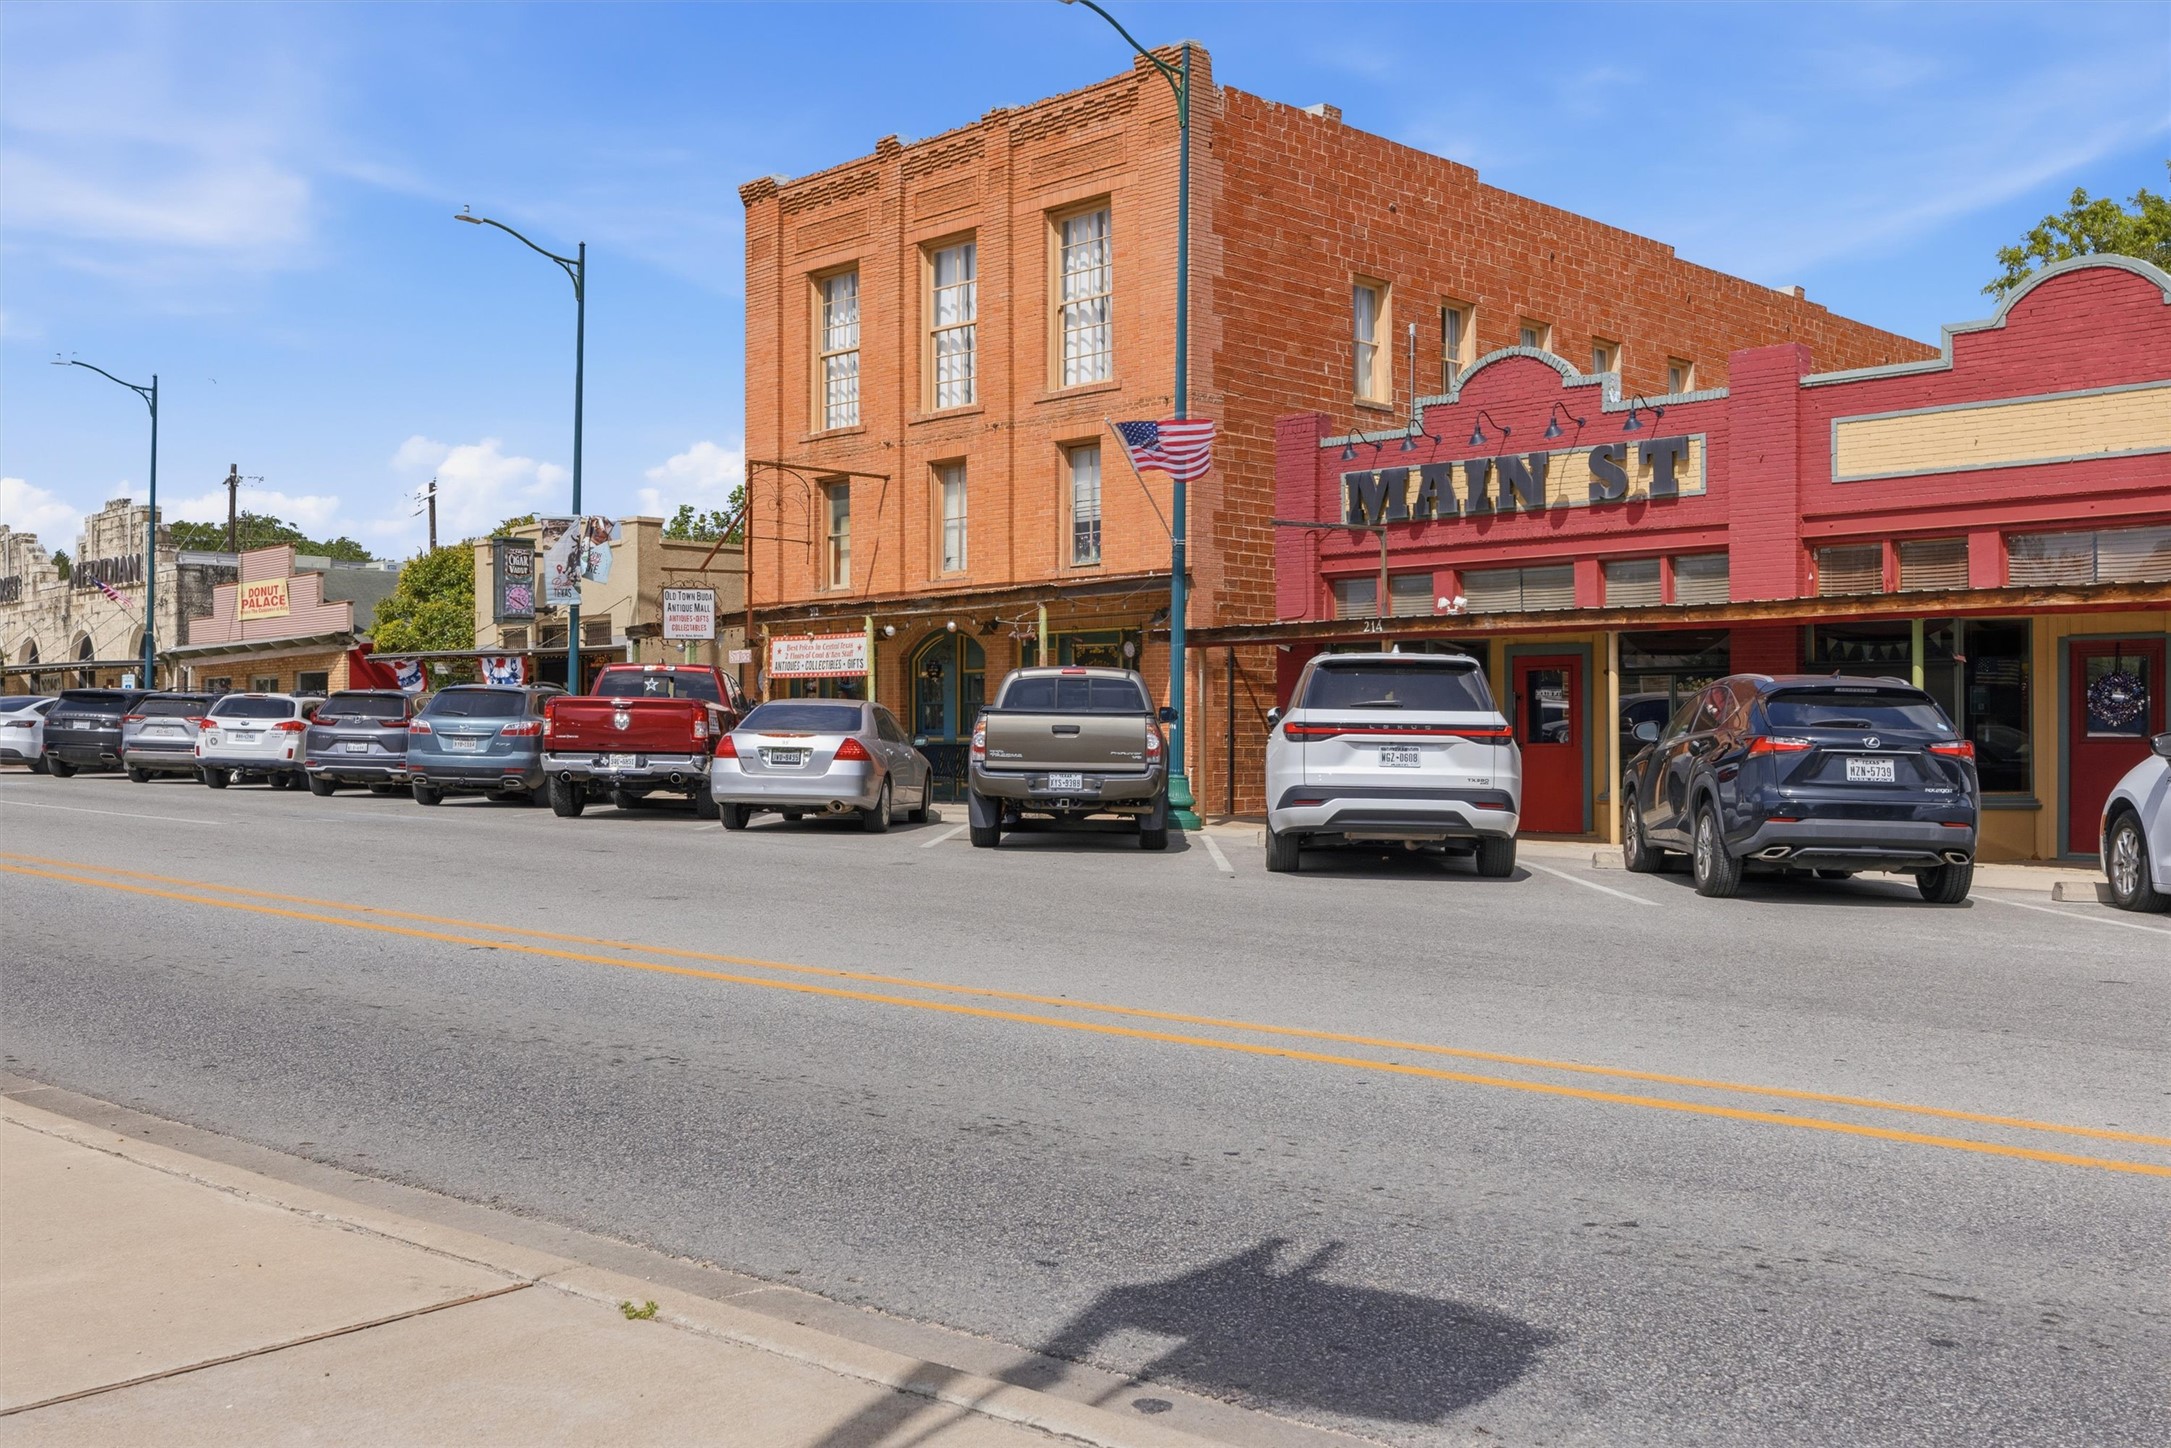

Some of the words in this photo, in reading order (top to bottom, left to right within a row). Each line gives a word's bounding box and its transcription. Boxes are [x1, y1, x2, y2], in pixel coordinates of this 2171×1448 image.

[1346, 451, 1548, 524] MAIN
[1588, 436, 1689, 500] ST
[508, 554, 529, 566] CIGAR
[69, 553, 143, 591] MERIDIAN
[248, 585, 279, 598] DONUT
[553, 588, 572, 598] TEXAS
[665, 591, 677, 601] OLD
[678, 591, 695, 601] TOWN
[696, 591, 713, 601] BUDA
[241, 595, 286, 609] PALACE
[667, 602, 693, 612] ANTIQUE
[694, 603, 711, 612] MALL
[1363, 620, 1383, 634] 214
[799, 643, 814, 651] Prices
[775, 661, 800, 671] ANTIQUES
[805, 659, 841, 671] COLLECTIBLES
[847, 658, 864, 669] GIFTS
